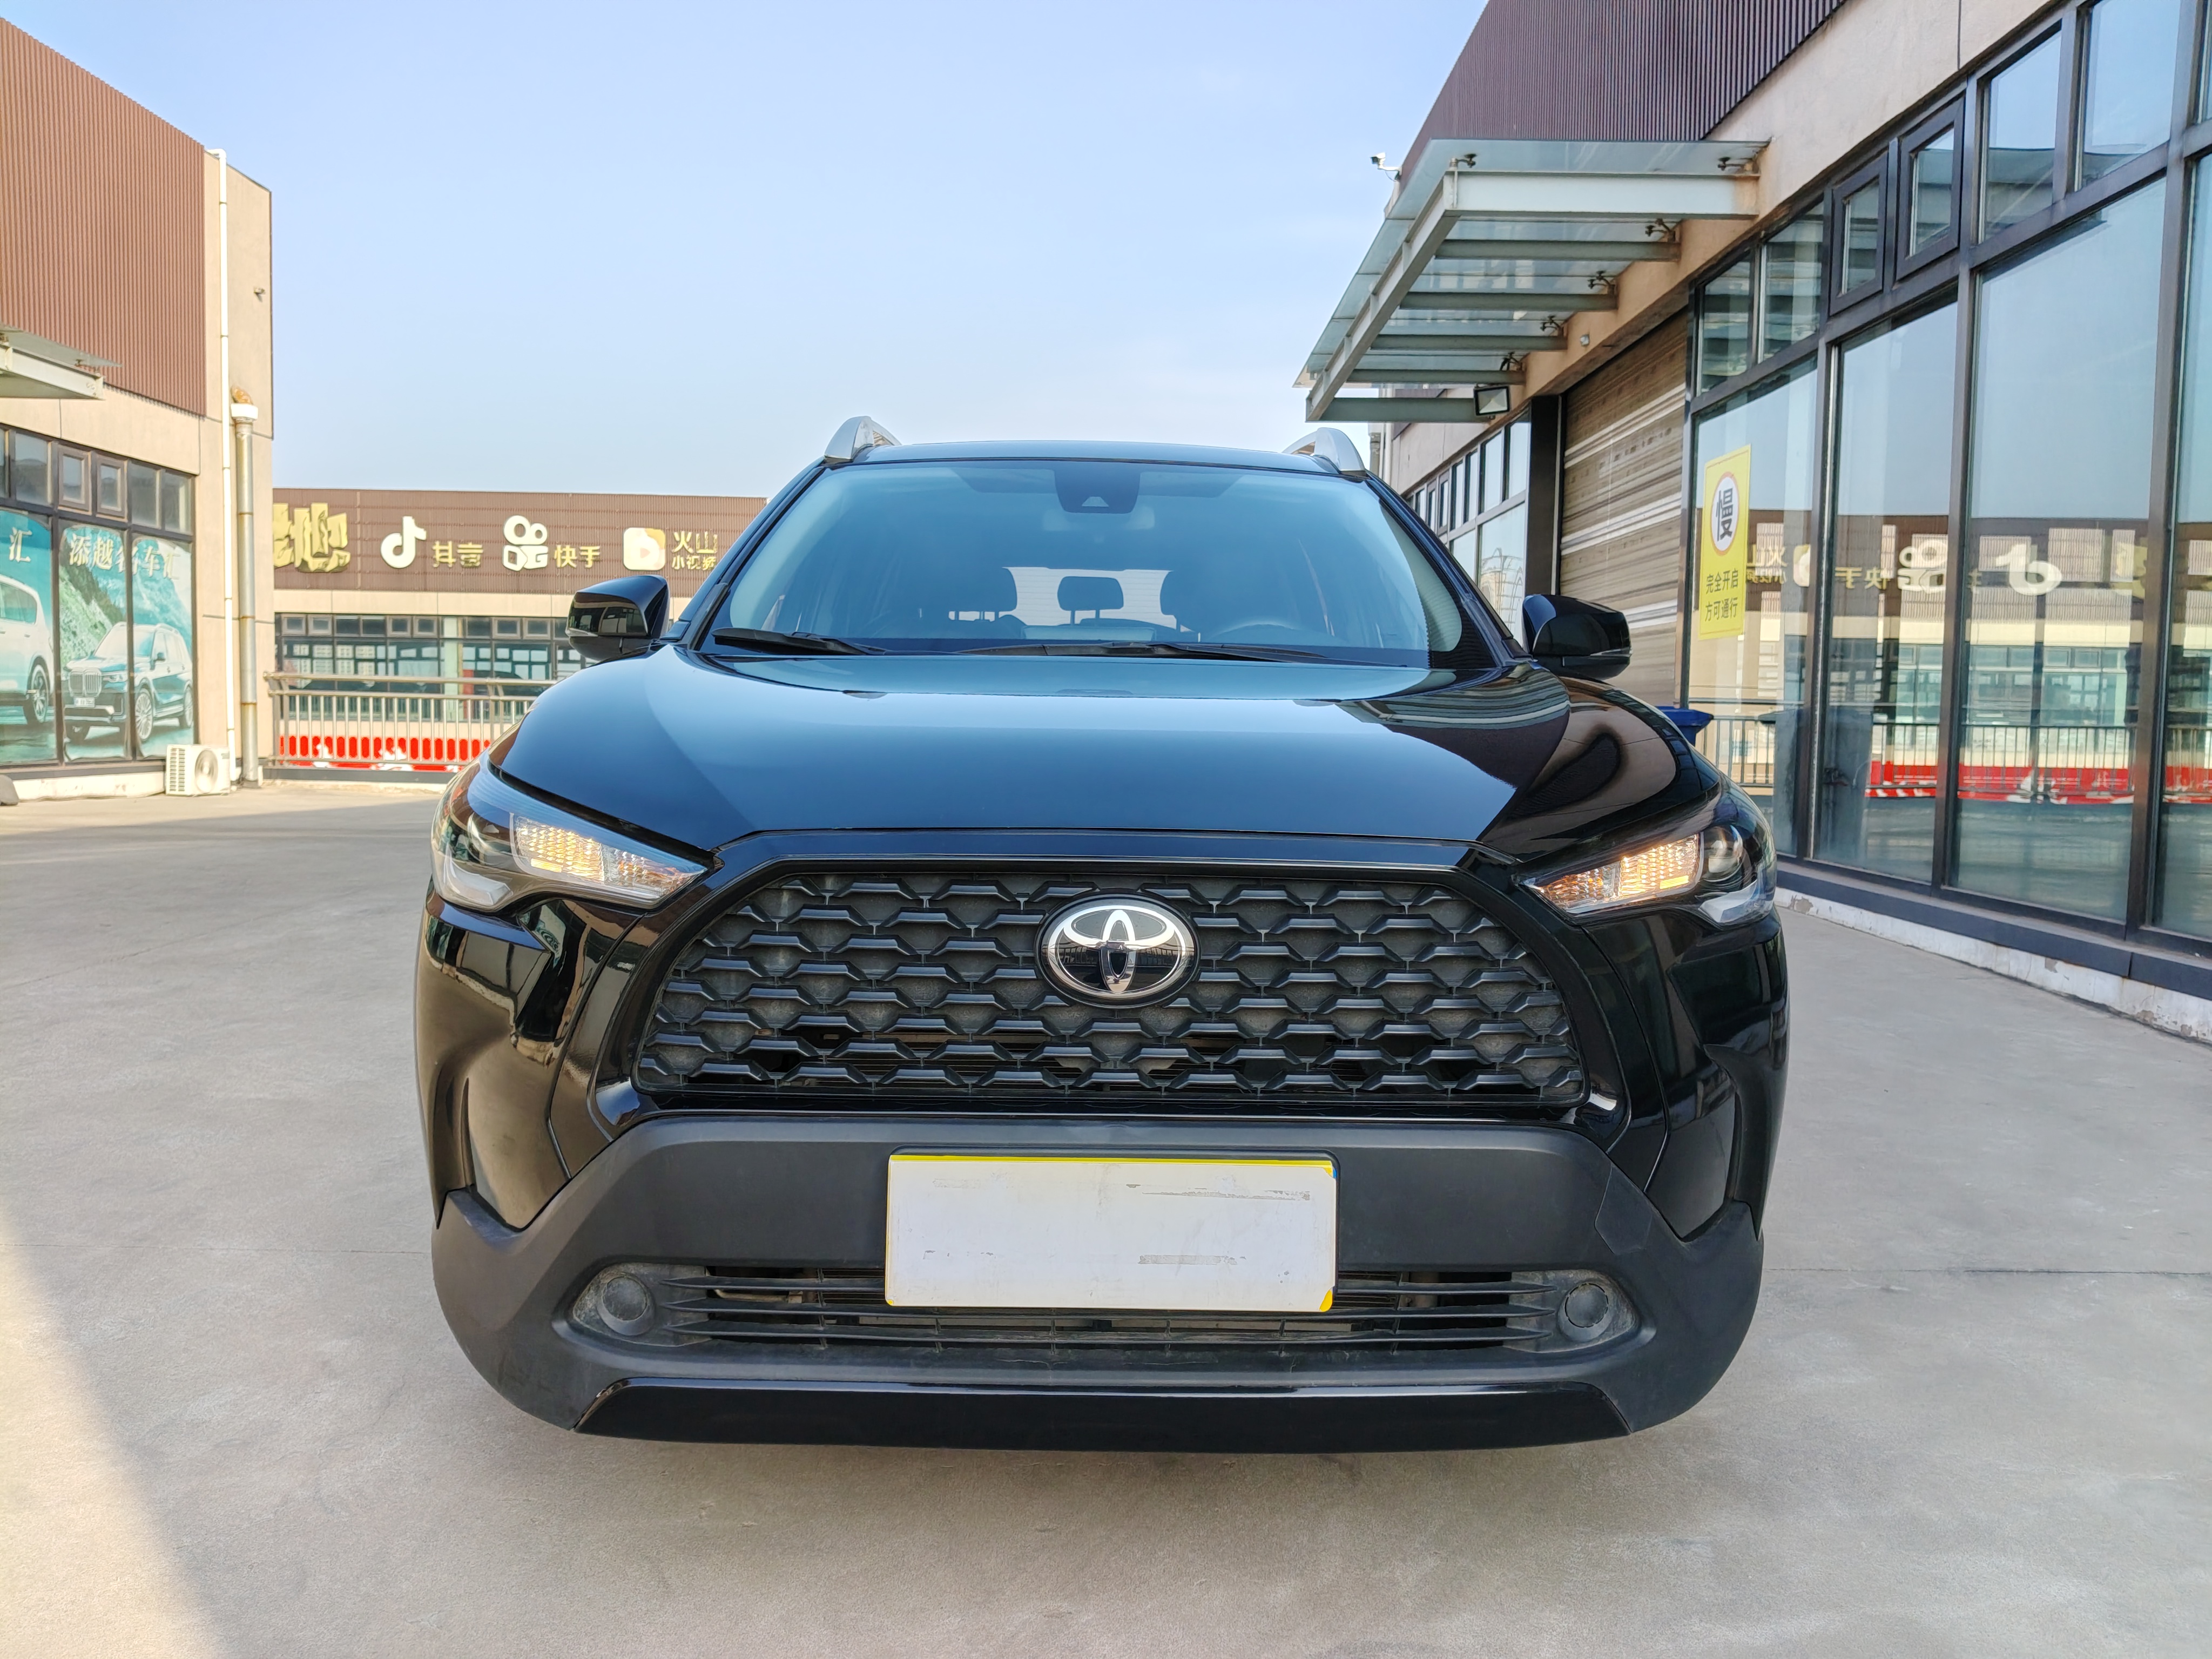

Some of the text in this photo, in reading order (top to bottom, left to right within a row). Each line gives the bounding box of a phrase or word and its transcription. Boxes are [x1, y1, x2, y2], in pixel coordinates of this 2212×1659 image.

[1715, 487, 1734, 542] 慢
[9, 527, 32, 563] 汇
[671, 530, 718, 554] 火山
[554, 544, 601, 569] 快手
[671, 555, 717, 571] 小视频
[1705, 568, 1739, 595] 完全开启
[1704, 597, 1738, 622] 方可通行
